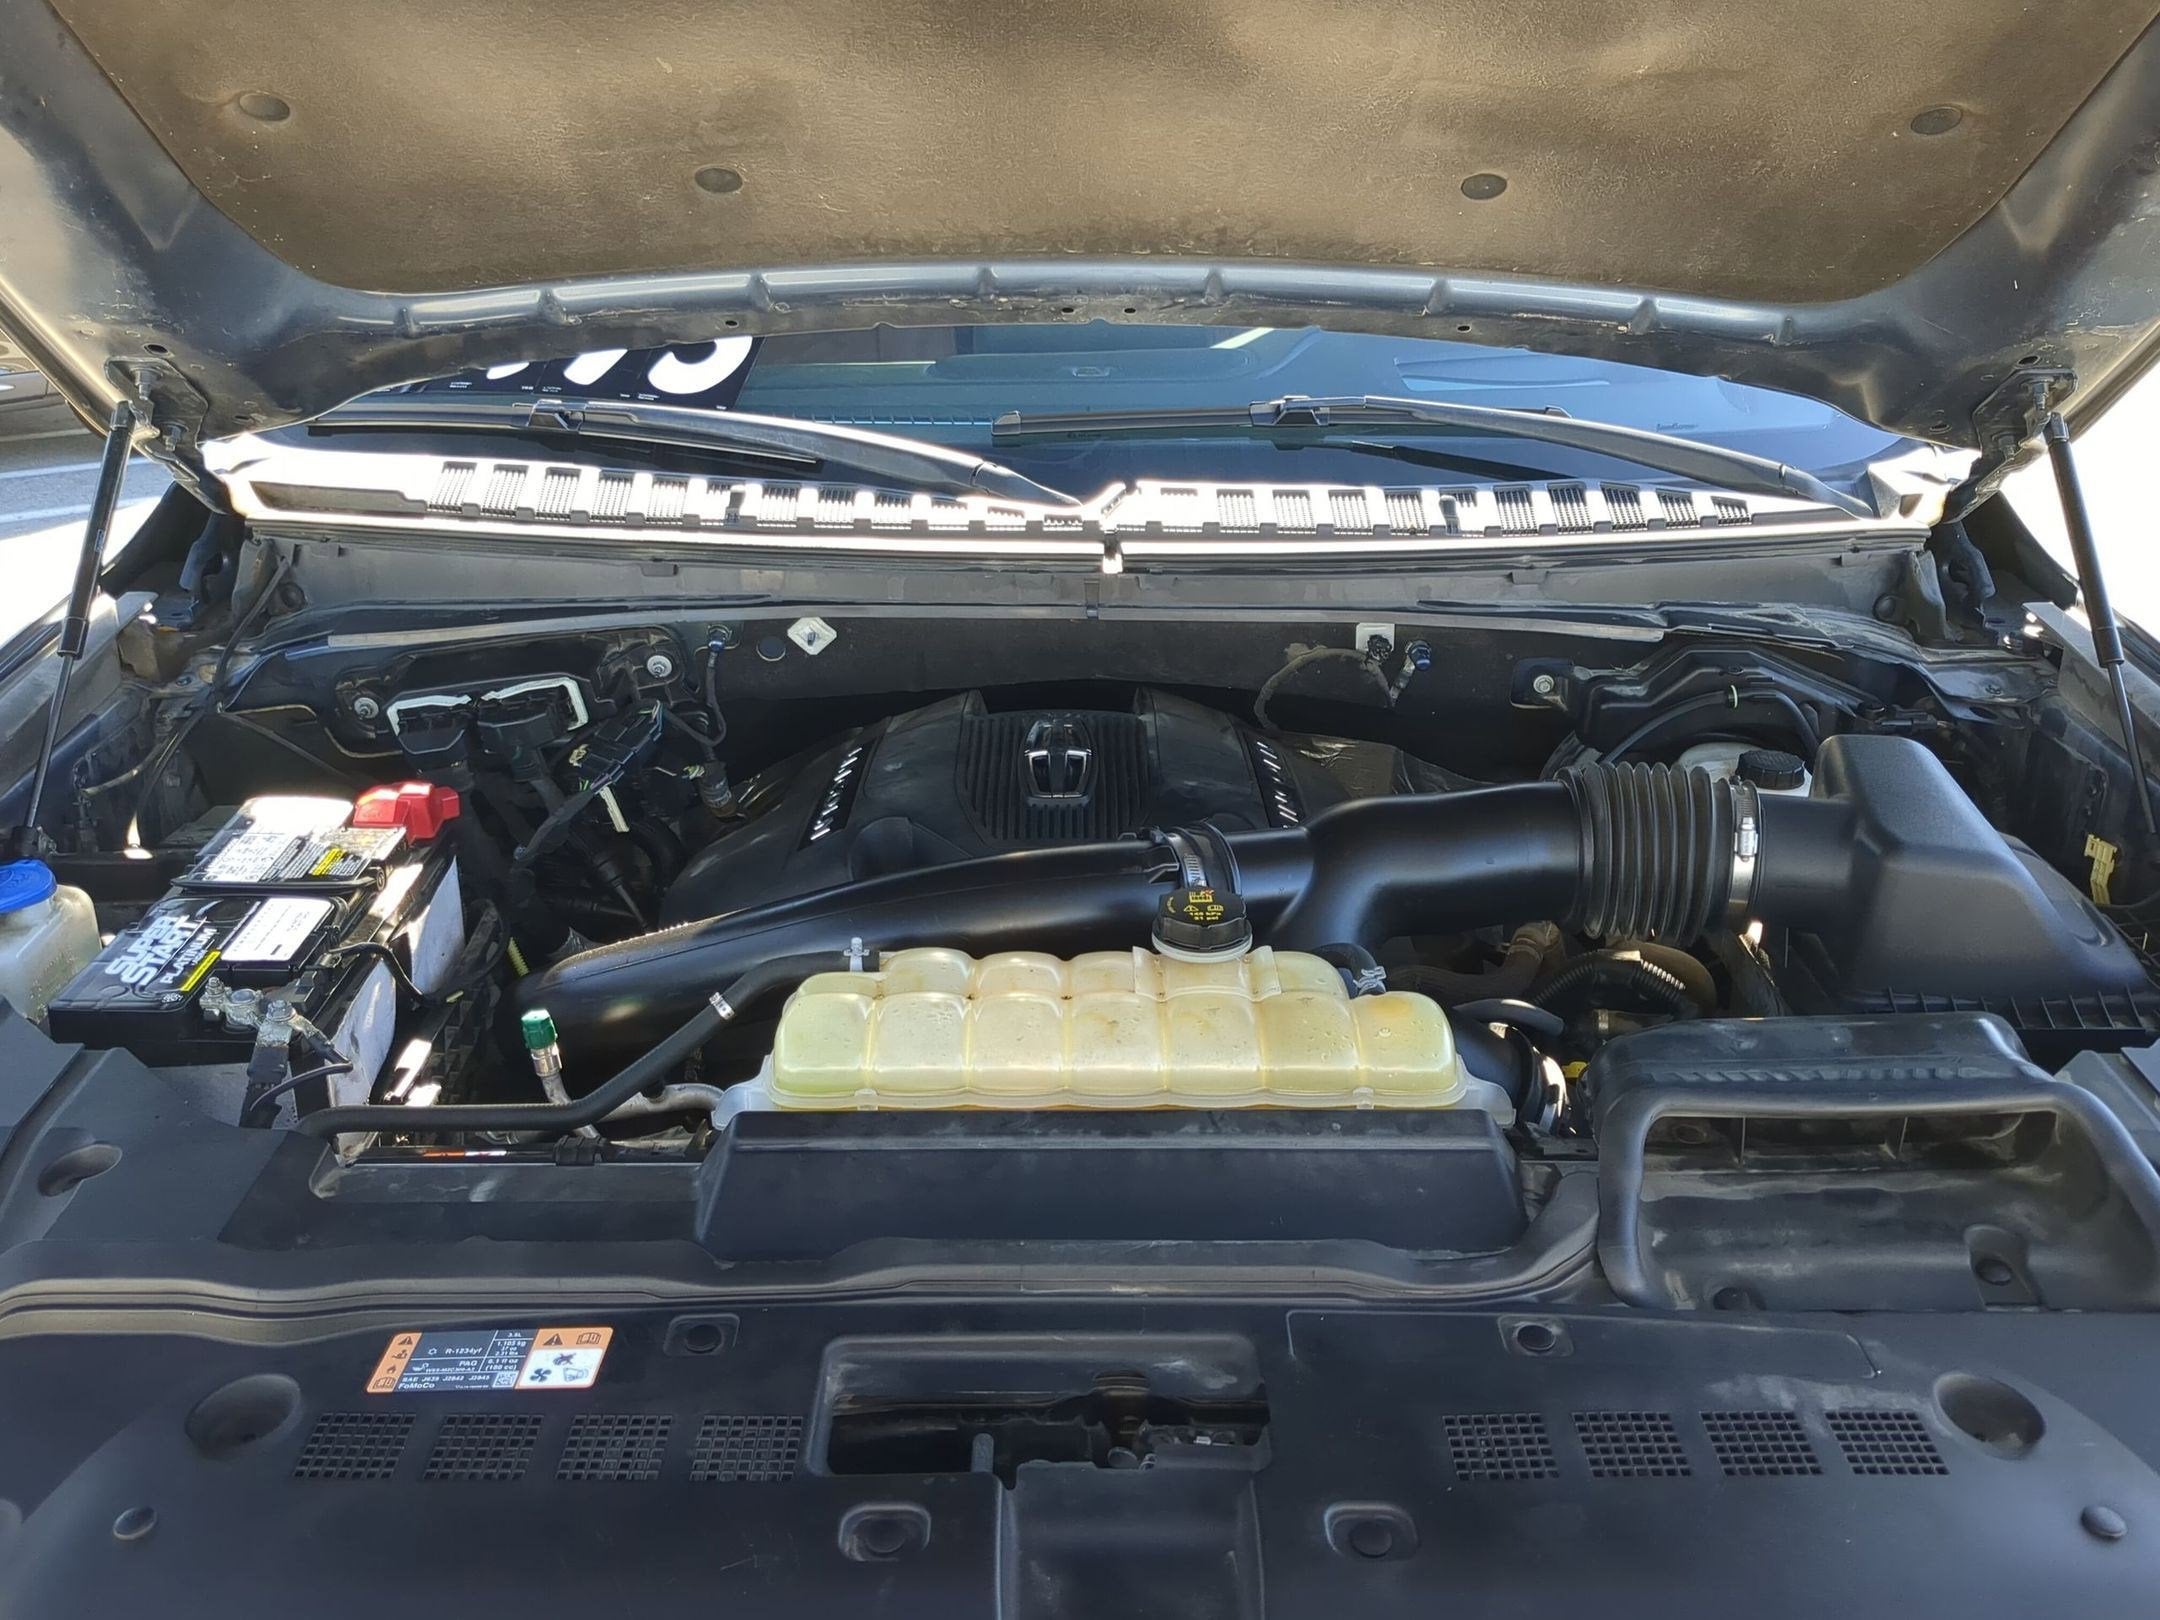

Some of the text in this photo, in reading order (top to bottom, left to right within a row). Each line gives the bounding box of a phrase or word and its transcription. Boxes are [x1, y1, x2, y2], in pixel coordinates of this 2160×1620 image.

[104, 915, 177, 975] SUPER
[120, 914, 199, 986] START
[159, 927, 218, 985] PLATINUM
[444, 1347, 483, 1355] R-1234yf
[398, 1382, 436, 1390] FoMoCo
